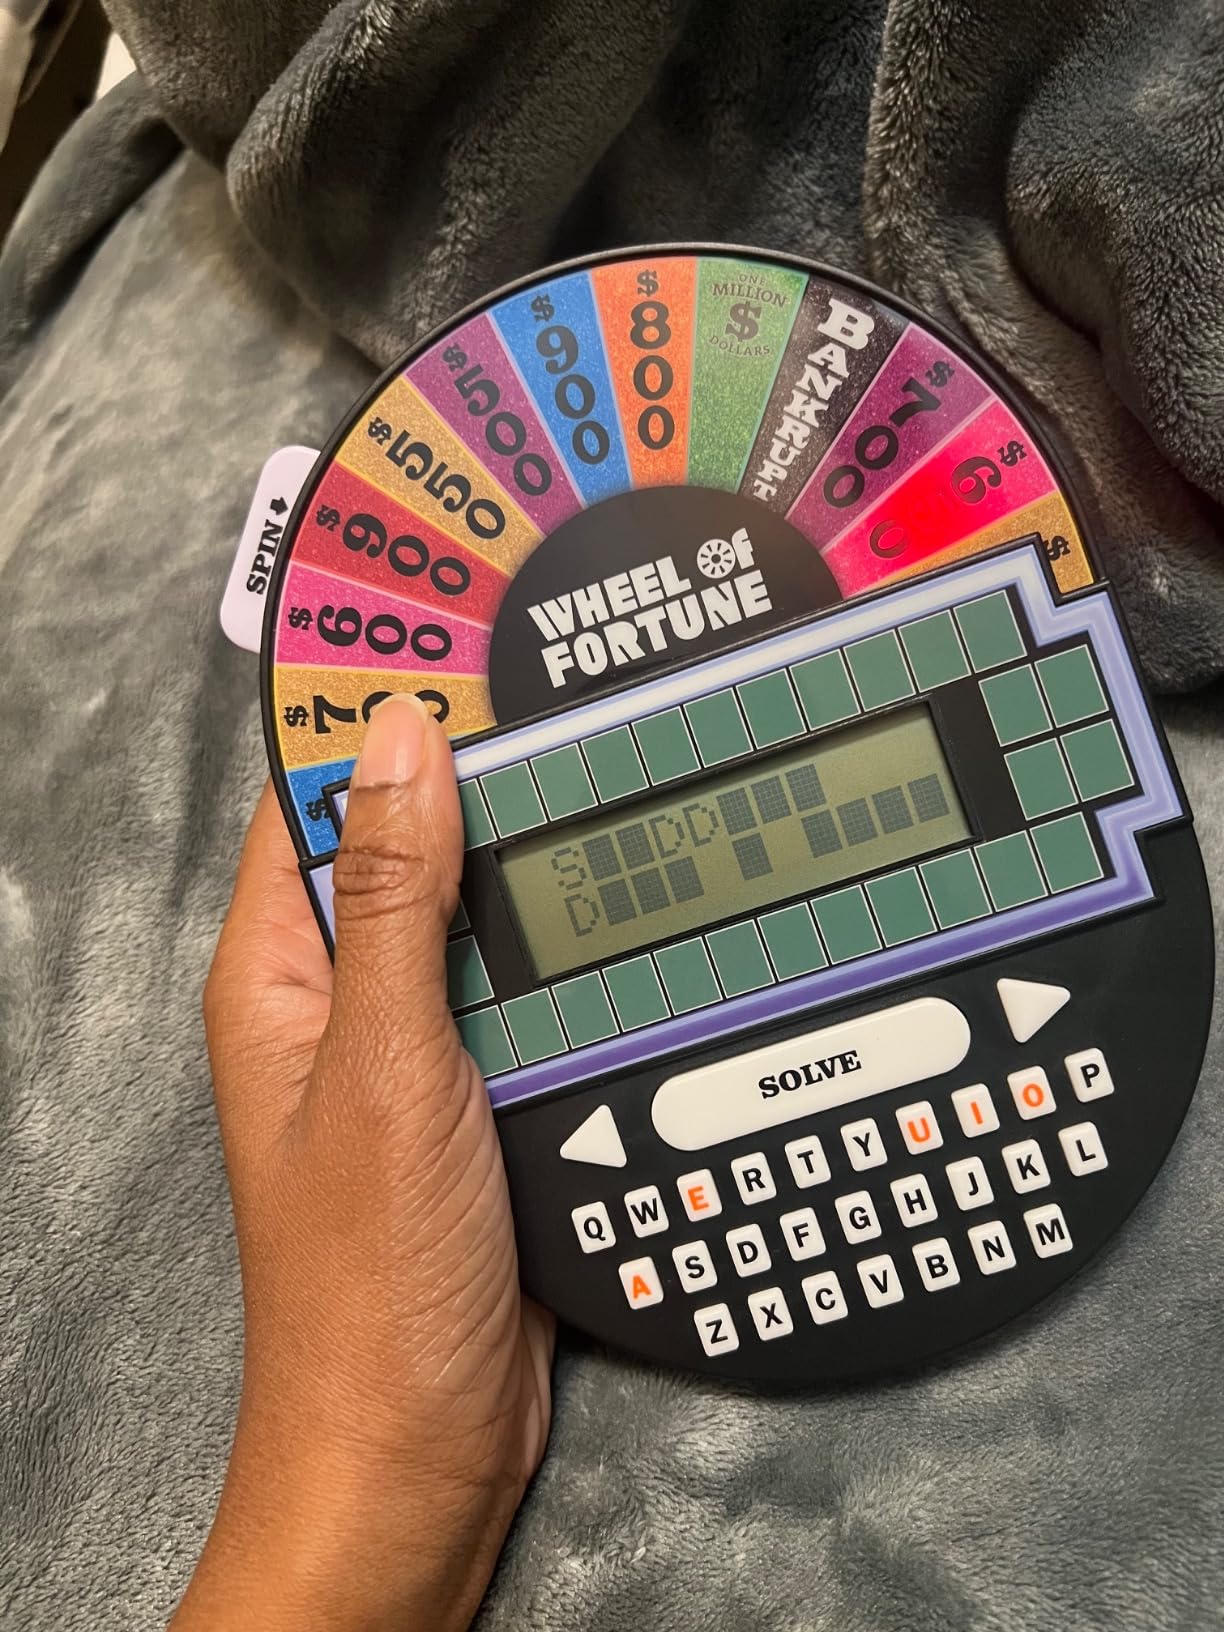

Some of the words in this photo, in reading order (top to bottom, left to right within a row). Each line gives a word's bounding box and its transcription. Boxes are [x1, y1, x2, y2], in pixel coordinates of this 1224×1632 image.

[712, 283, 788, 308] MILLION
[738, 273, 766, 287] ONE
[710, 335, 770, 356] DOLLARS
[725, 300, 762, 343] $
[753, 298, 875, 502] BANKRUPT
[246, 519, 284, 595] SPIN
[527, 555, 693, 642] WHEEL
[541, 569, 773, 689] FORTUNE
[757, 1049, 863, 1100] SOLVE
[583, 1216, 607, 1242] Q
[629, 1197, 659, 1226] W
[687, 1185, 710, 1212] E
[741, 1167, 766, 1193] R
[796, 1149, 815, 1175] T
[852, 1132, 871, 1157] Y
[907, 1117, 931, 1144] U
[970, 1102, 984, 1125] I
[1022, 1083, 1045, 1108] O
[1080, 1063, 1100, 1089] P
[632, 1275, 652, 1300] A
[684, 1255, 705, 1279] S
[736, 1240, 759, 1265] D
[791, 1222, 810, 1249] F
[848, 1206, 872, 1230] G
[903, 1188, 928, 1215] H
[967, 1171, 979, 1197] J
[1015, 1154, 1041, 1181] K
[1075, 1139, 1097, 1162] L
[705, 1318, 729, 1345] Z
[759, 1302, 784, 1329] X
[815, 1287, 836, 1311] C
[868, 1269, 888, 1295] V
[924, 1254, 949, 1279] B
[981, 1235, 1006, 1262] N
[1035, 1217, 1066, 1246] M
